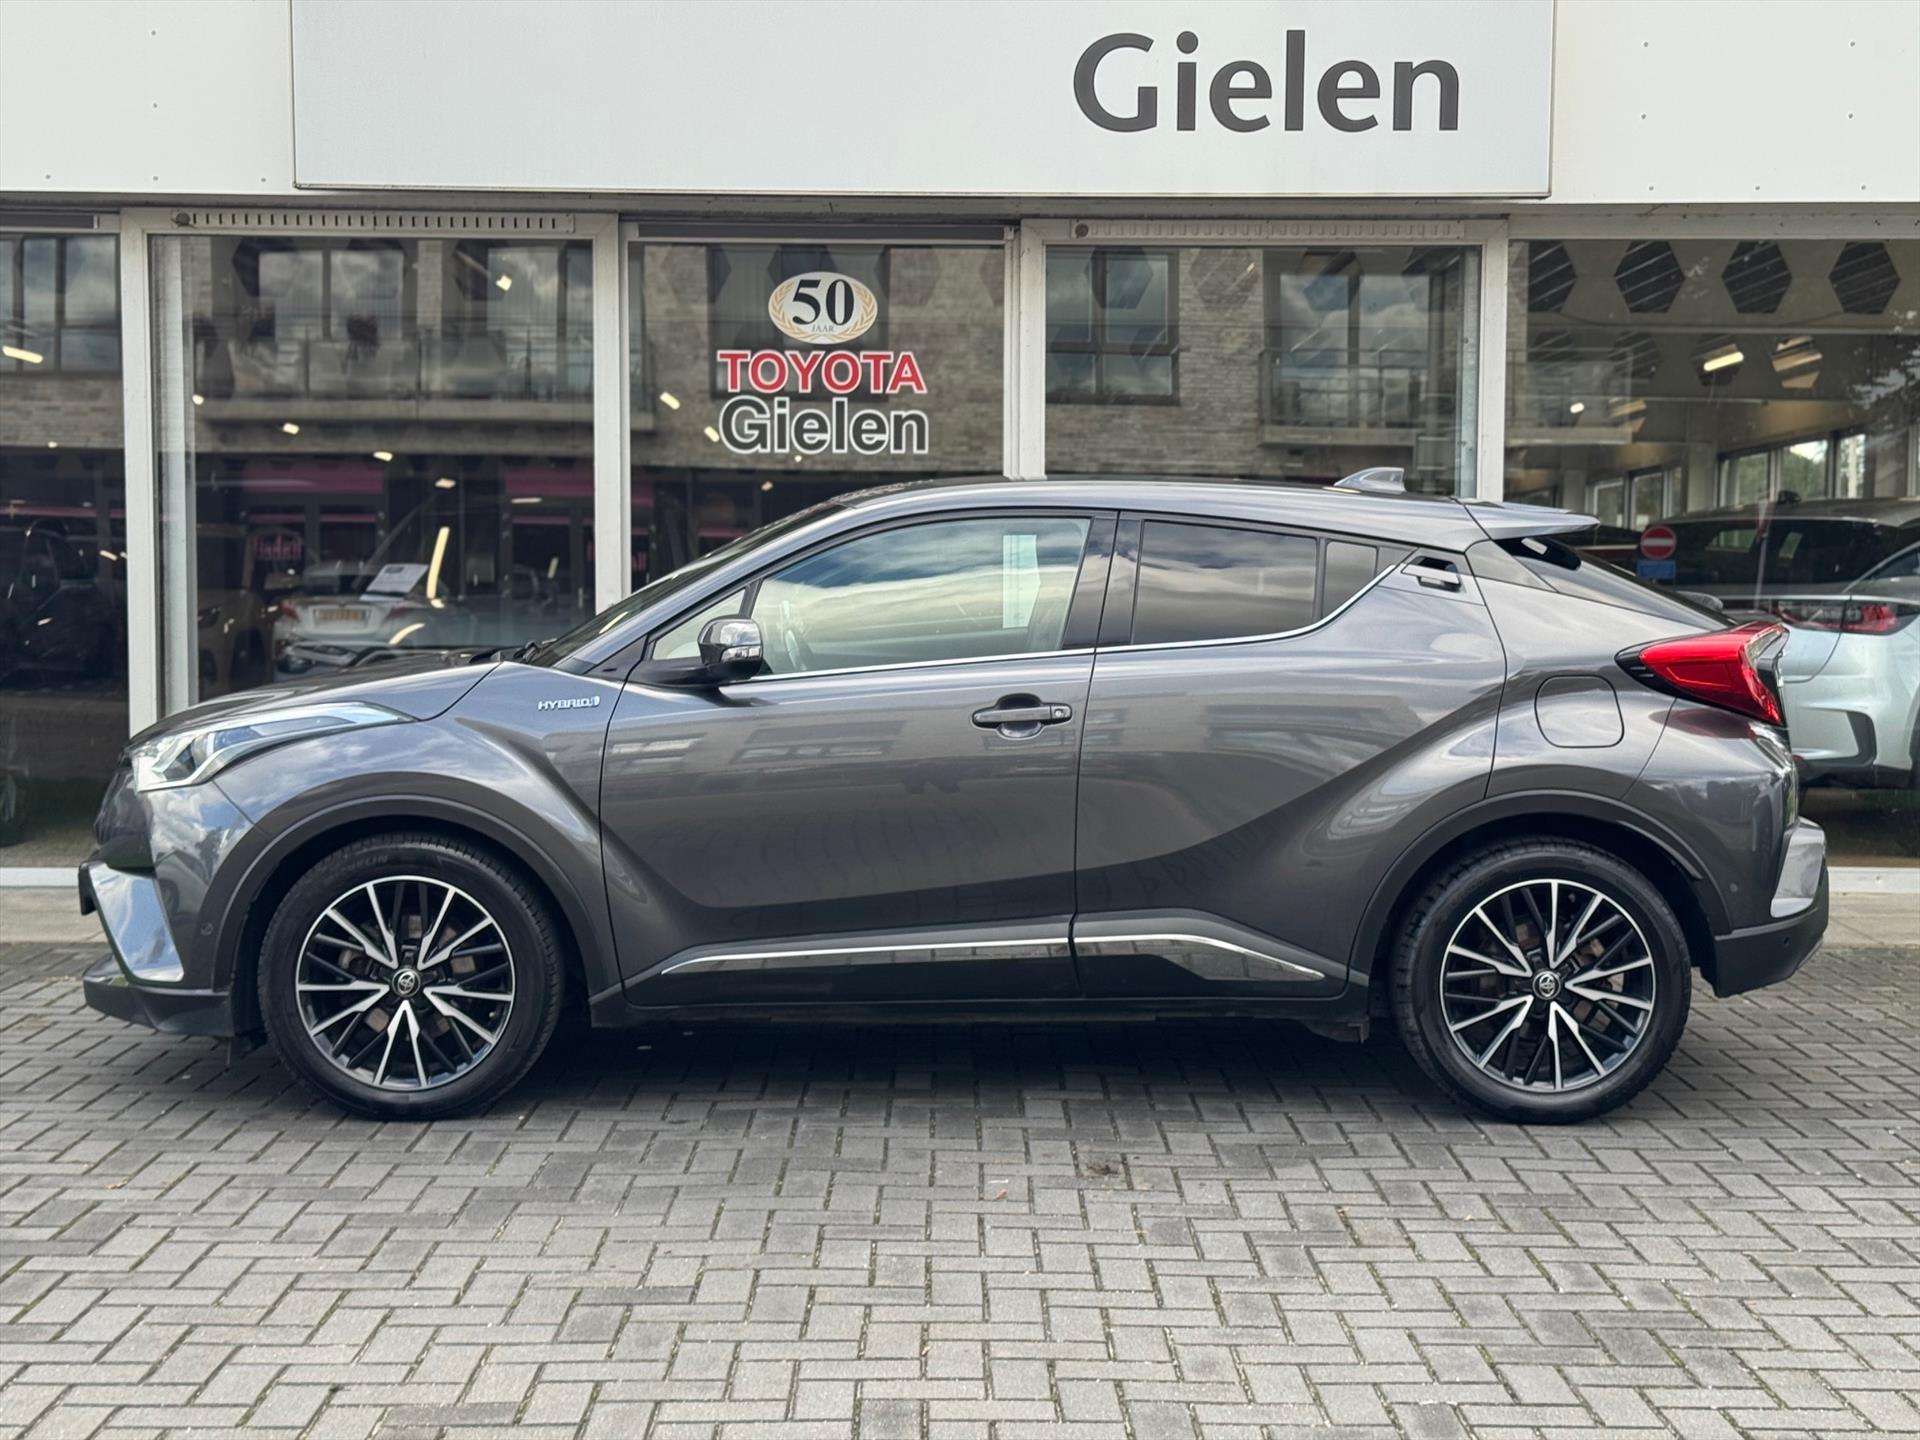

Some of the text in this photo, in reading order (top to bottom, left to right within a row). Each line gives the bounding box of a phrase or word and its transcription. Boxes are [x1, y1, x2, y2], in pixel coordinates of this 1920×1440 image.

[1073, 29, 1460, 133] Gielen
[792, 279, 855, 326] 50
[811, 324, 835, 333] JAAR
[717, 350, 928, 395] TOYOTA
[719, 395, 929, 455] Gielen
[537, 697, 590, 711] HYBRID
